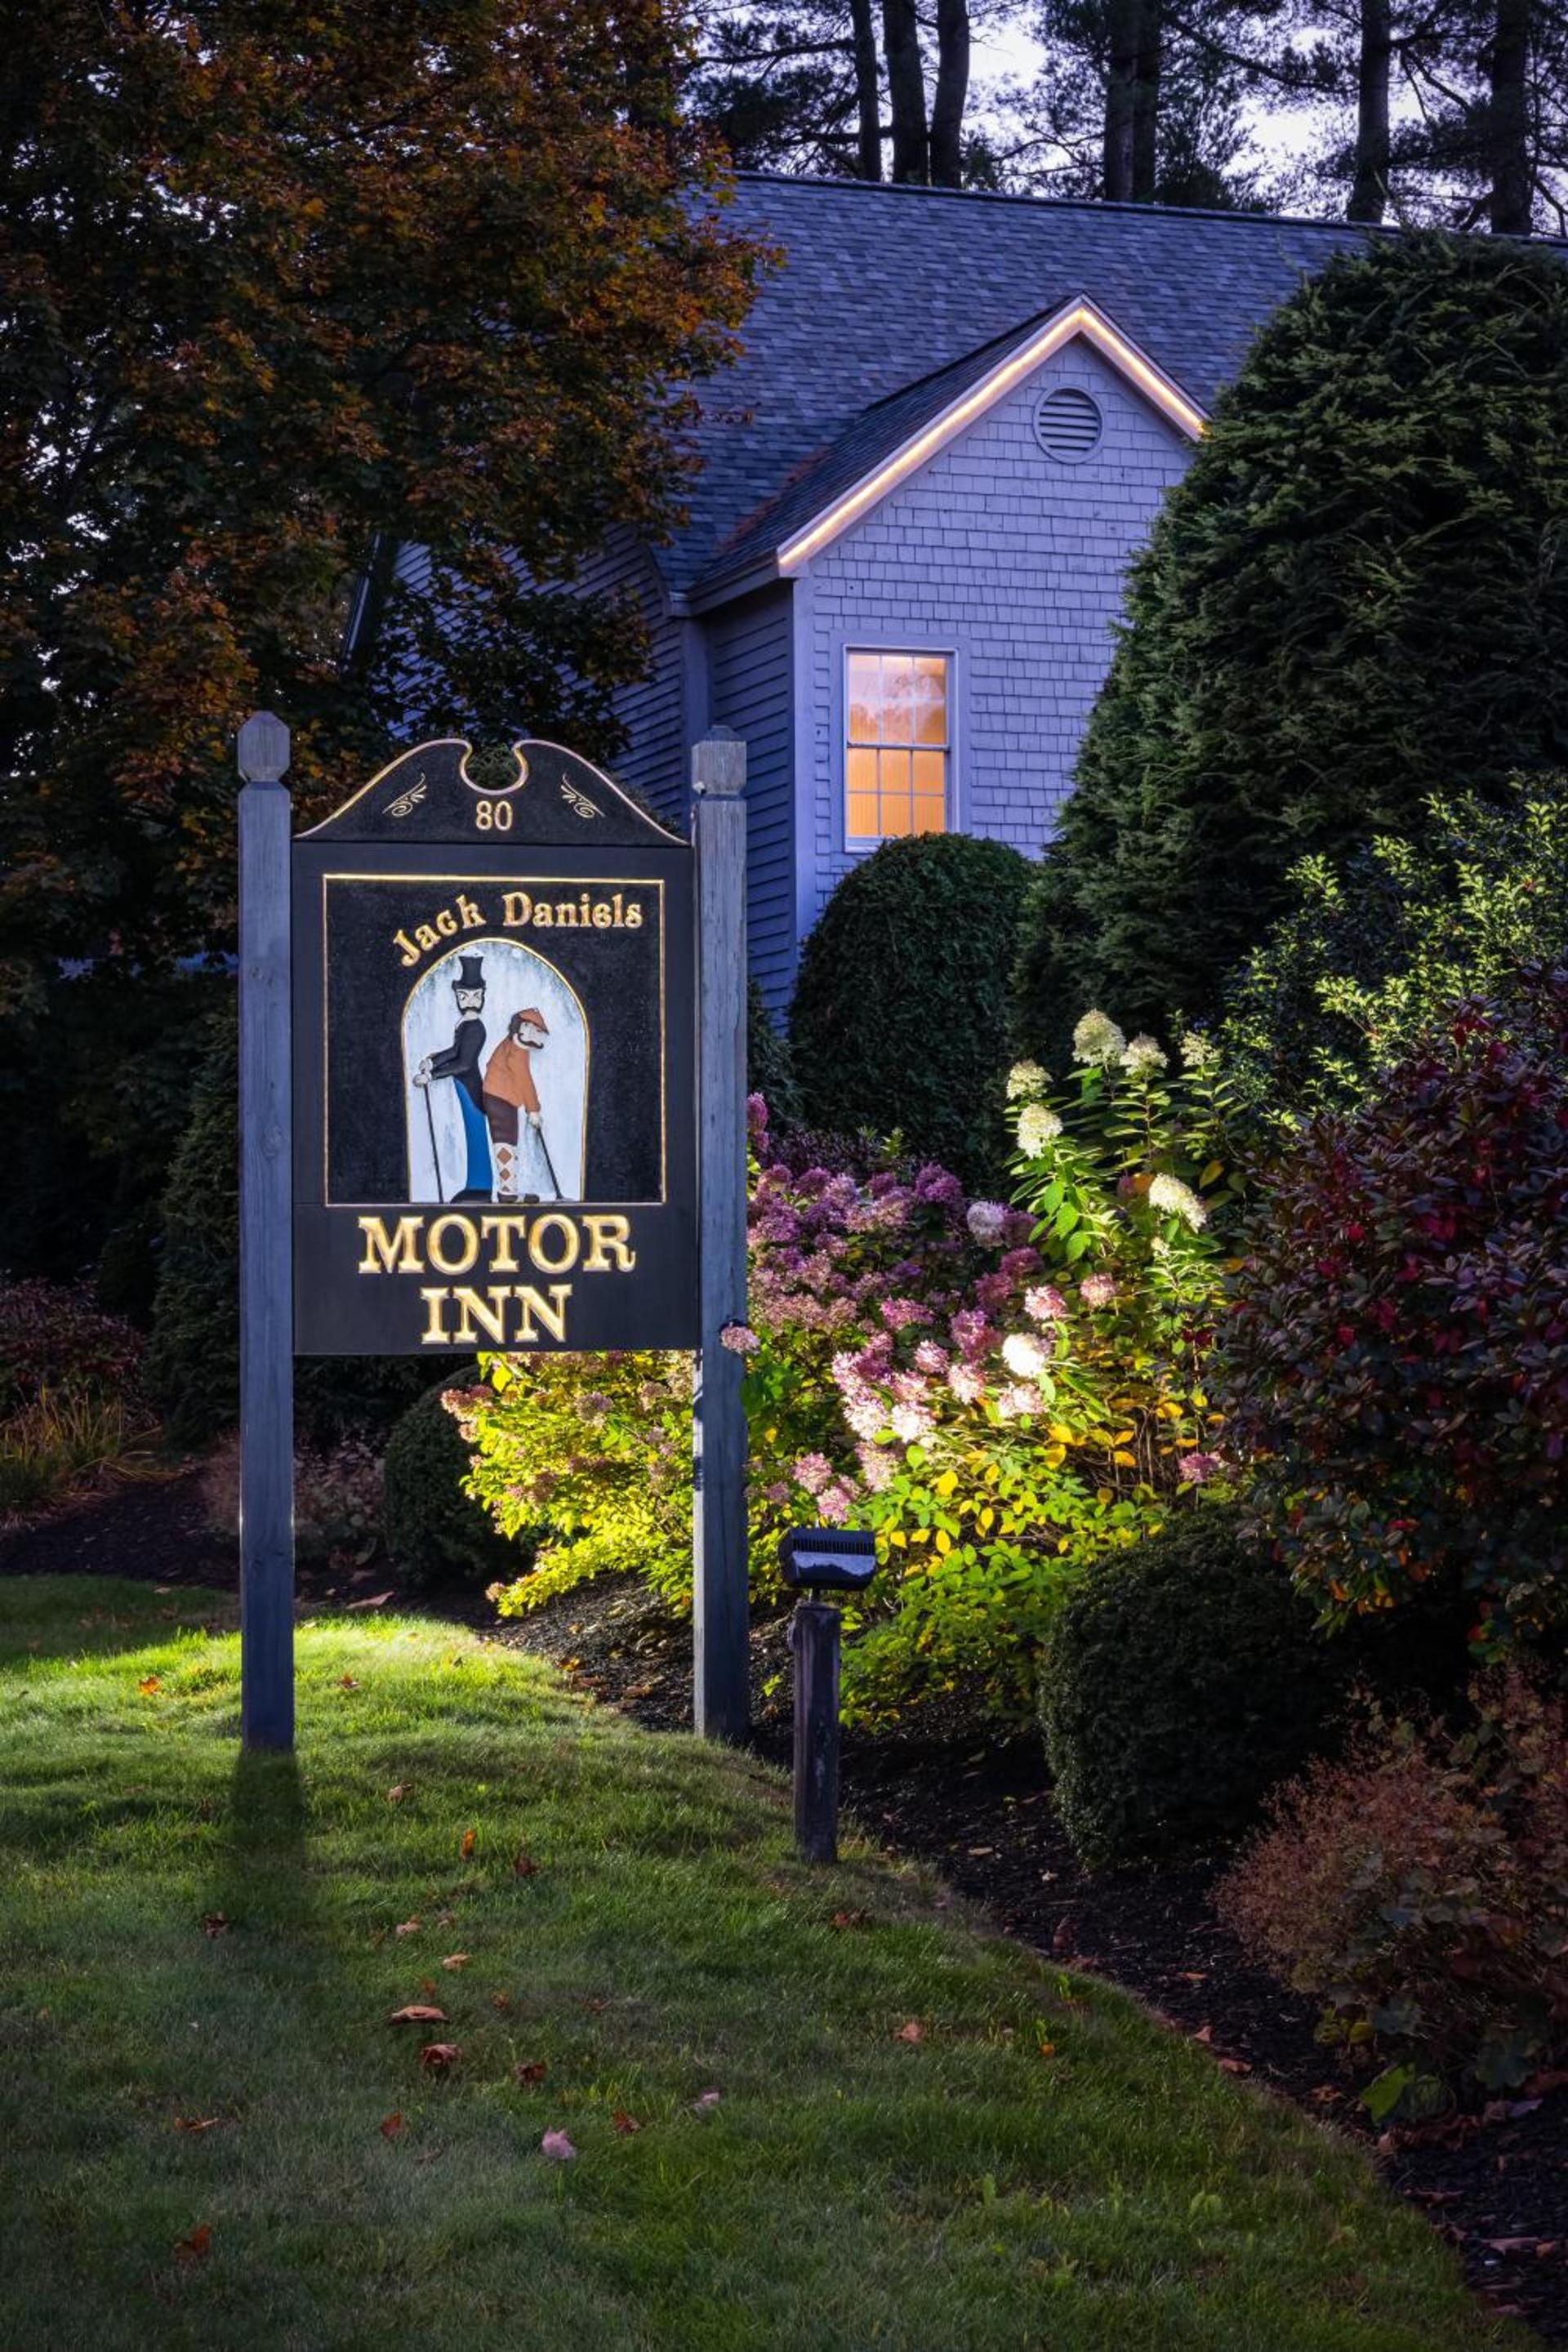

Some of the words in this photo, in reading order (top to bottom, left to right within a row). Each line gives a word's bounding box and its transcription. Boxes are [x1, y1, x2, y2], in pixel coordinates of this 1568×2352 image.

[475, 800, 514, 831] 80
[392, 894, 487, 967] Jack
[501, 891, 644, 929] Daniels
[357, 1213, 637, 1276] MOTOR
[419, 1283, 573, 1345] INN
